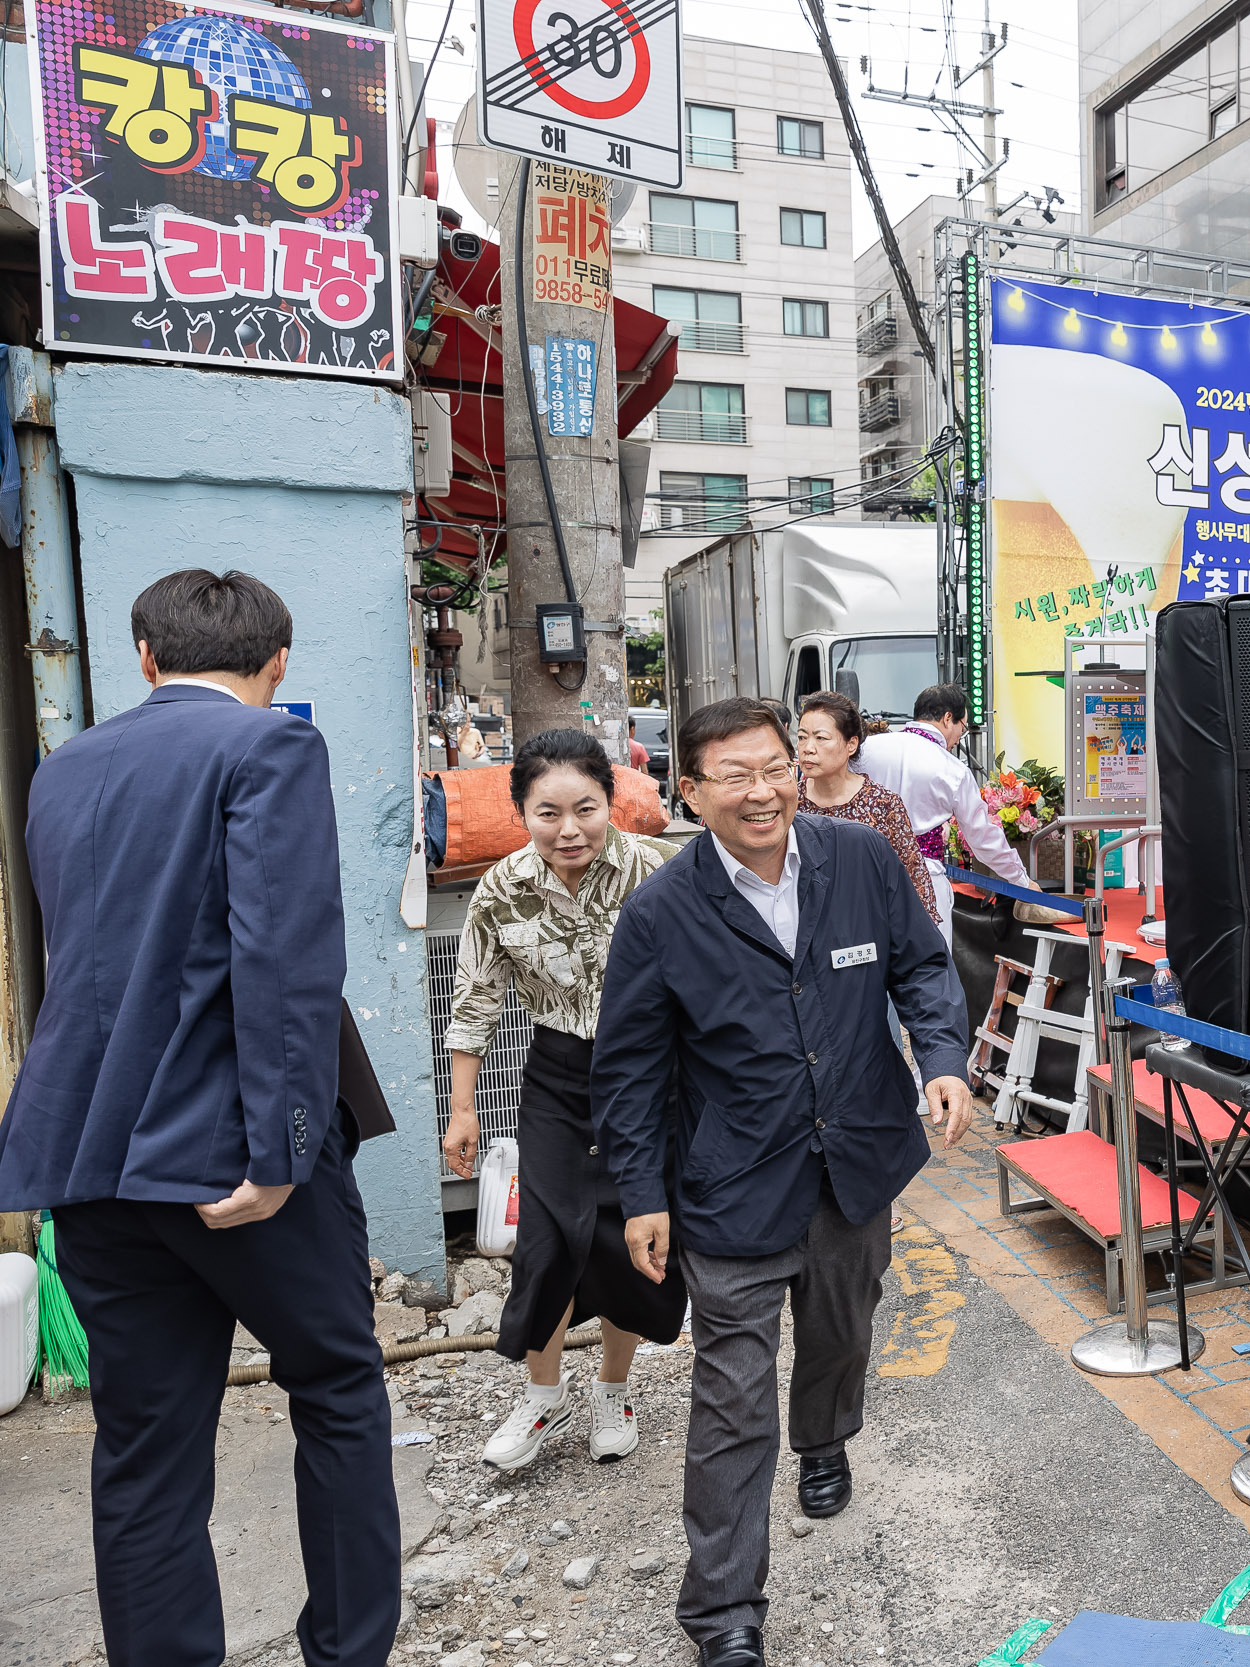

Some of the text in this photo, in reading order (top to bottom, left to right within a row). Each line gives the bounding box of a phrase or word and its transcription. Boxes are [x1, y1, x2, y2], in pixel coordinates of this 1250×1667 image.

[546, 12, 622, 79] 30
[64, 200, 378, 323] 노래짱
[535, 254, 571, 278] 011
[1195, 520, 1250, 544] 행사무대
[1095, 703, 1145, 716] 맥주축제
